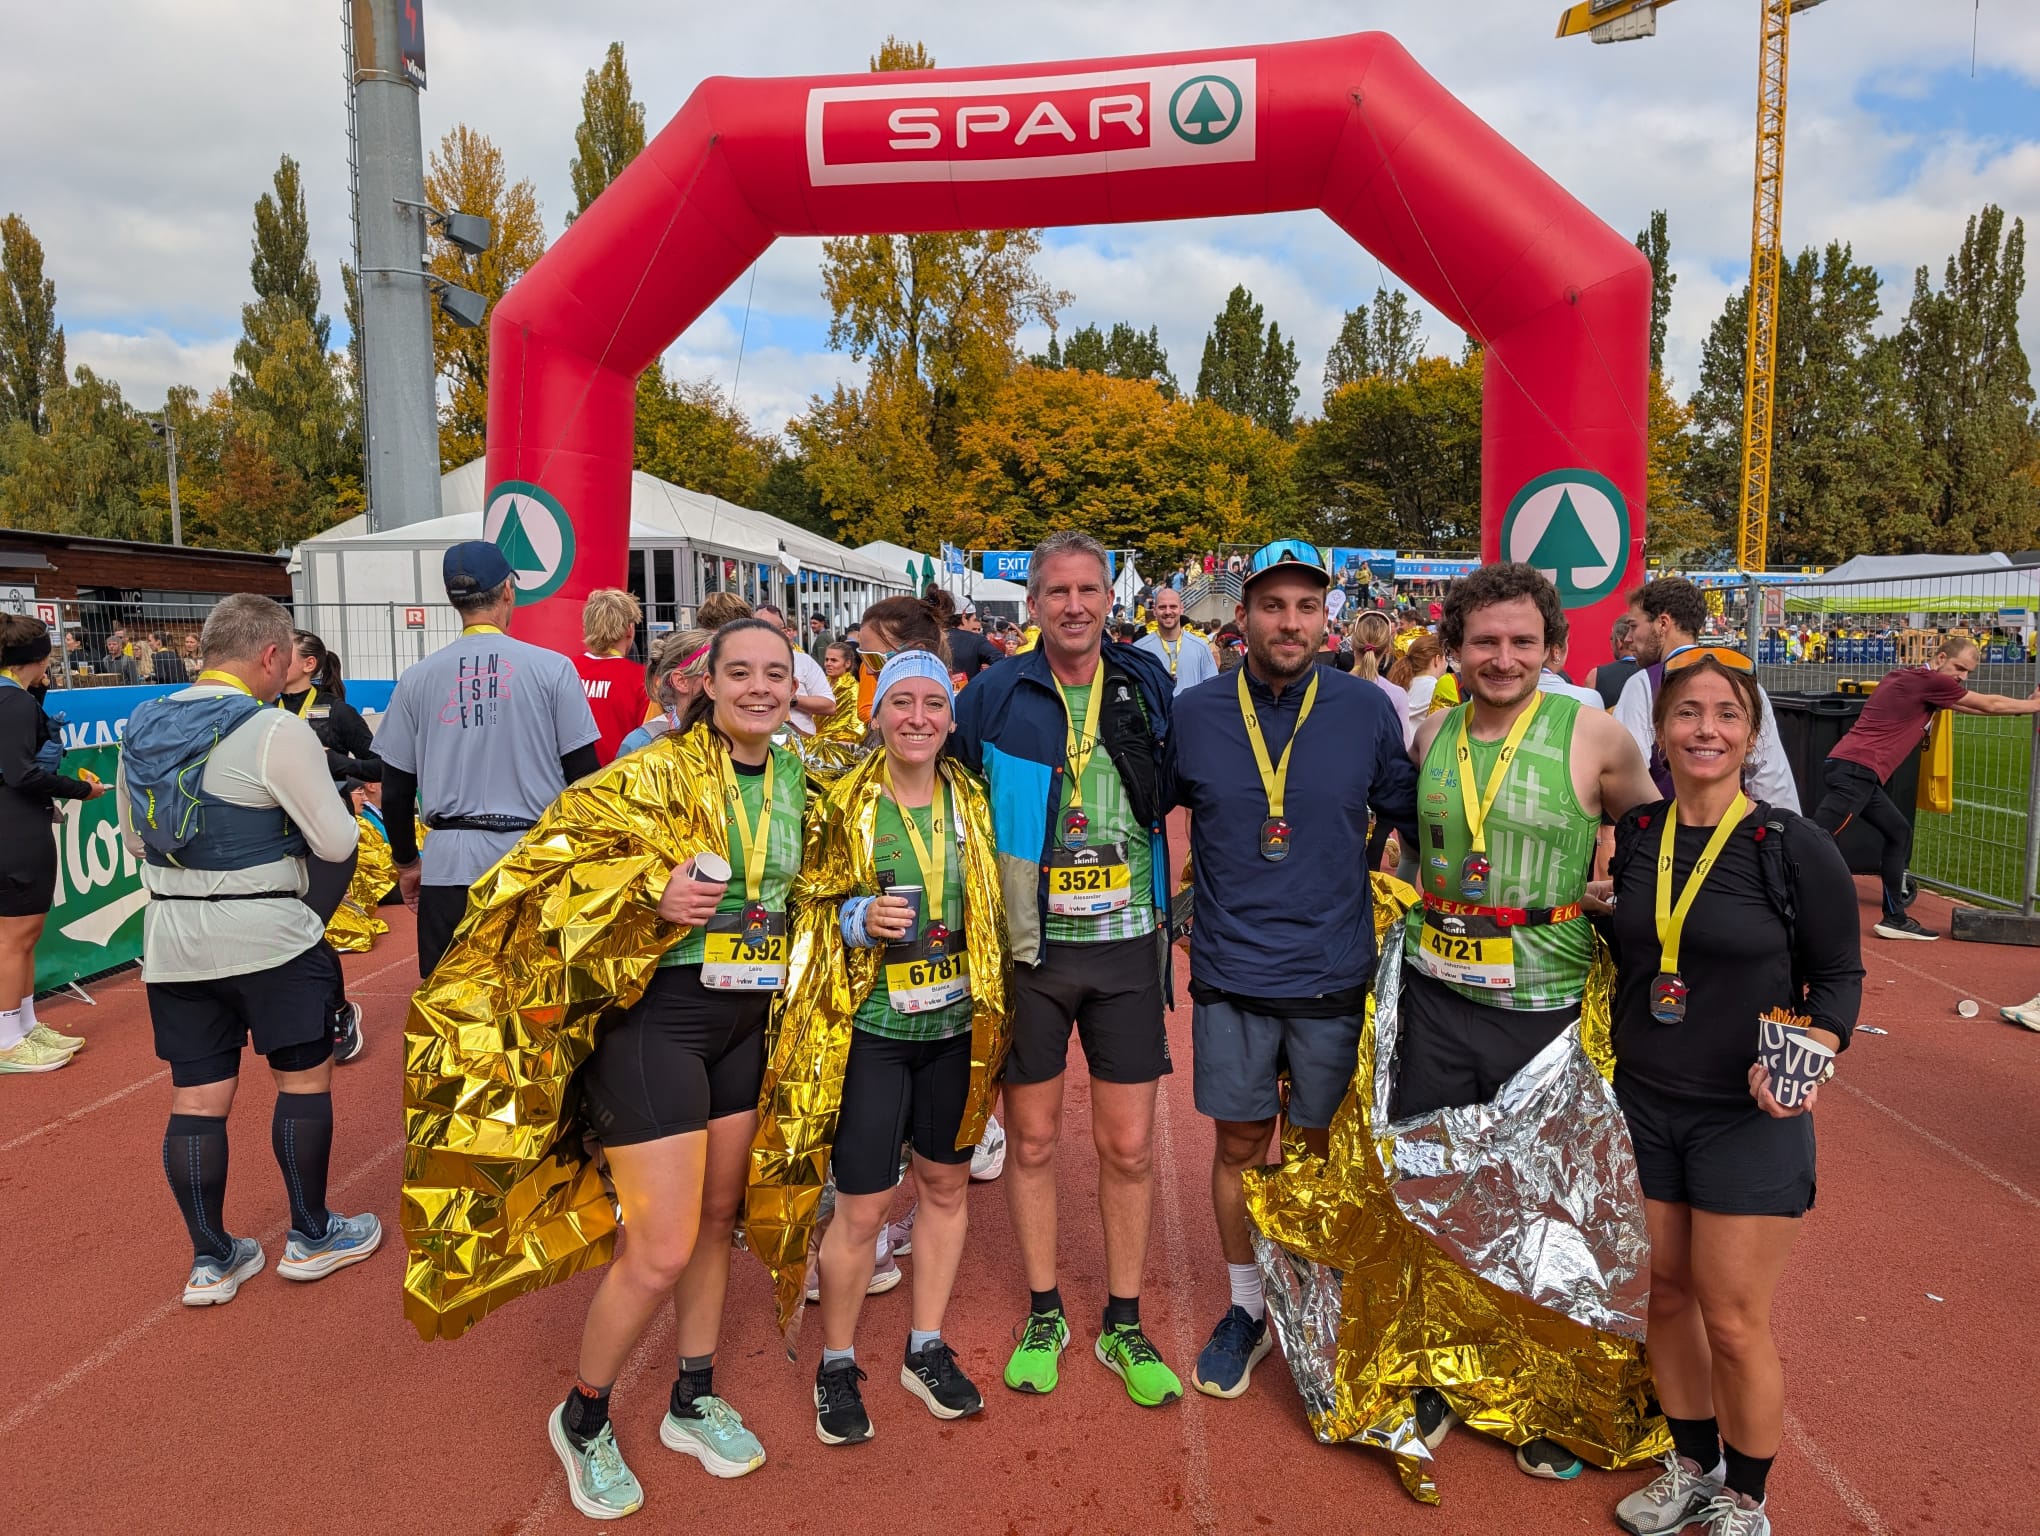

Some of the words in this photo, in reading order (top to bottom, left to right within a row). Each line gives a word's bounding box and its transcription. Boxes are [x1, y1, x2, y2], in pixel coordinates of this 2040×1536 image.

[888, 93, 1143, 150] SPAR
[120, 591, 141, 606] WC
[40, 607, 54, 621] R
[408, 610, 423, 622] R
[460, 654, 498, 678] FIN
[461, 704, 484, 728] ER
[145, 787, 158, 830] SALOMON
[1074, 857, 1098, 865] skinfit
[1058, 868, 1111, 892] 3521
[729, 938, 781, 961] 7392
[1431, 934, 1483, 962] 4721
[909, 955, 961, 986] 6781
